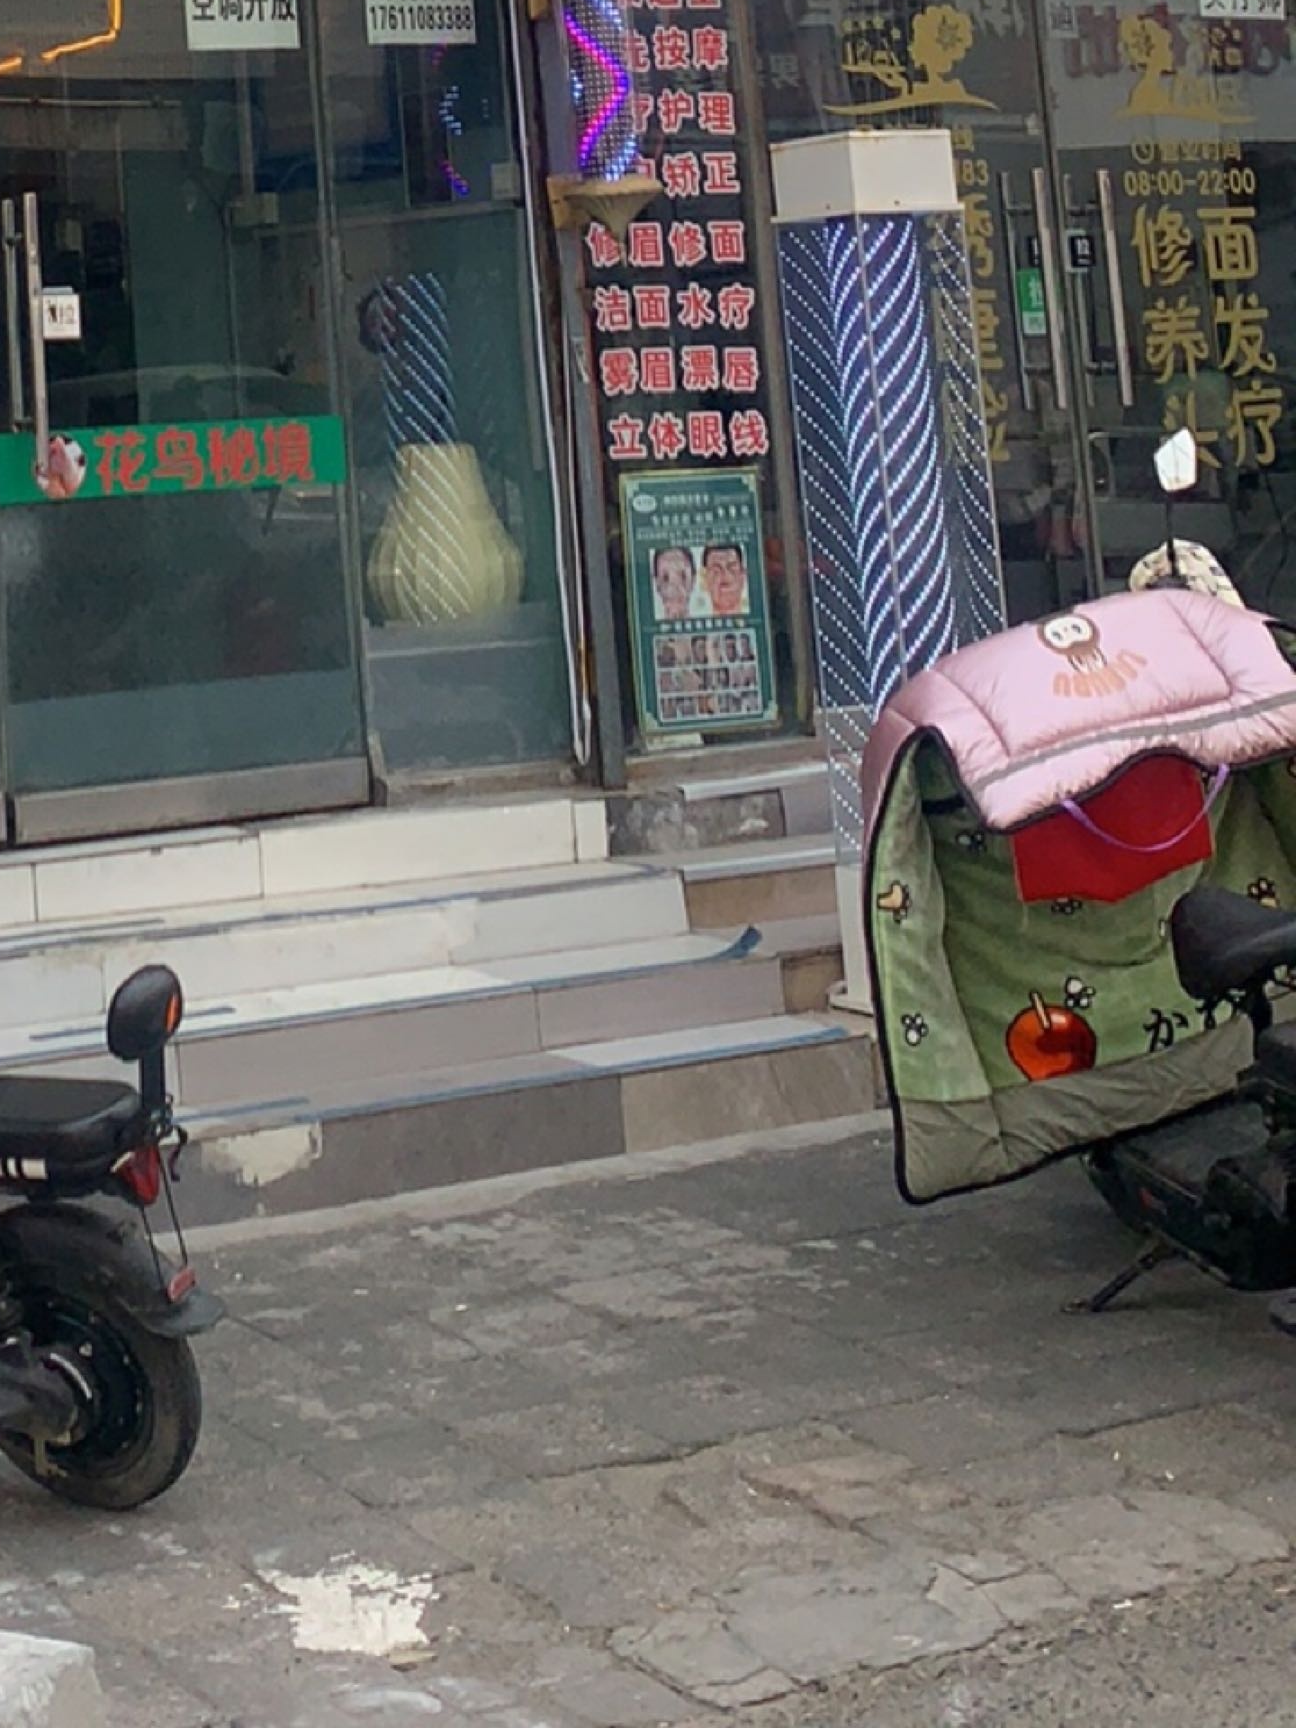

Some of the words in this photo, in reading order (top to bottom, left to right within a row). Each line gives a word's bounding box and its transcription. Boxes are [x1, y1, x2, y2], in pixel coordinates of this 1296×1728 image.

[1124, 168, 1256, 197] 08:00-22:00
[585, 221, 745, 268] 修眉修面
[593, 282, 755, 332] 洁面水疗
[609, 409, 769, 459] 立体眼线
